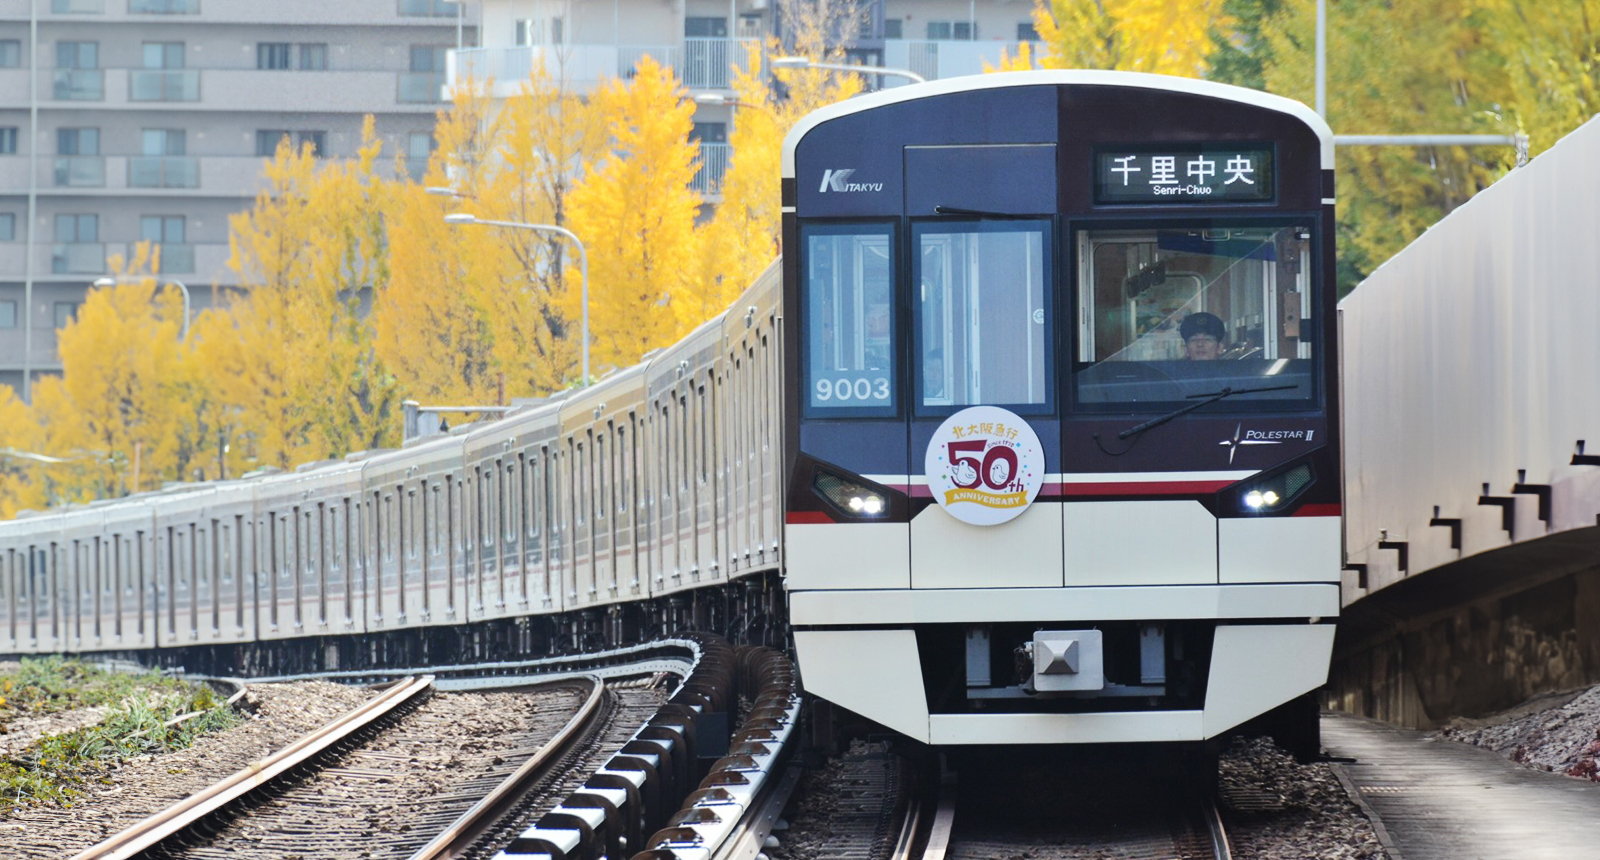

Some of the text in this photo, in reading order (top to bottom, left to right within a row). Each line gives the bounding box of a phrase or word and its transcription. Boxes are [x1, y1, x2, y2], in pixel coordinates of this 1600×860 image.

[1111, 155, 1254, 185] 千里中央
[819, 169, 883, 192] KITAKYU
[1153, 185, 1212, 195] Senri-Chuo
[816, 378, 889, 400] 9003
[952, 423, 1018, 439] 北大阪急行
[1246, 430, 1303, 439] POLESTAR
[953, 492, 1020, 505] ANNIVERSARY
